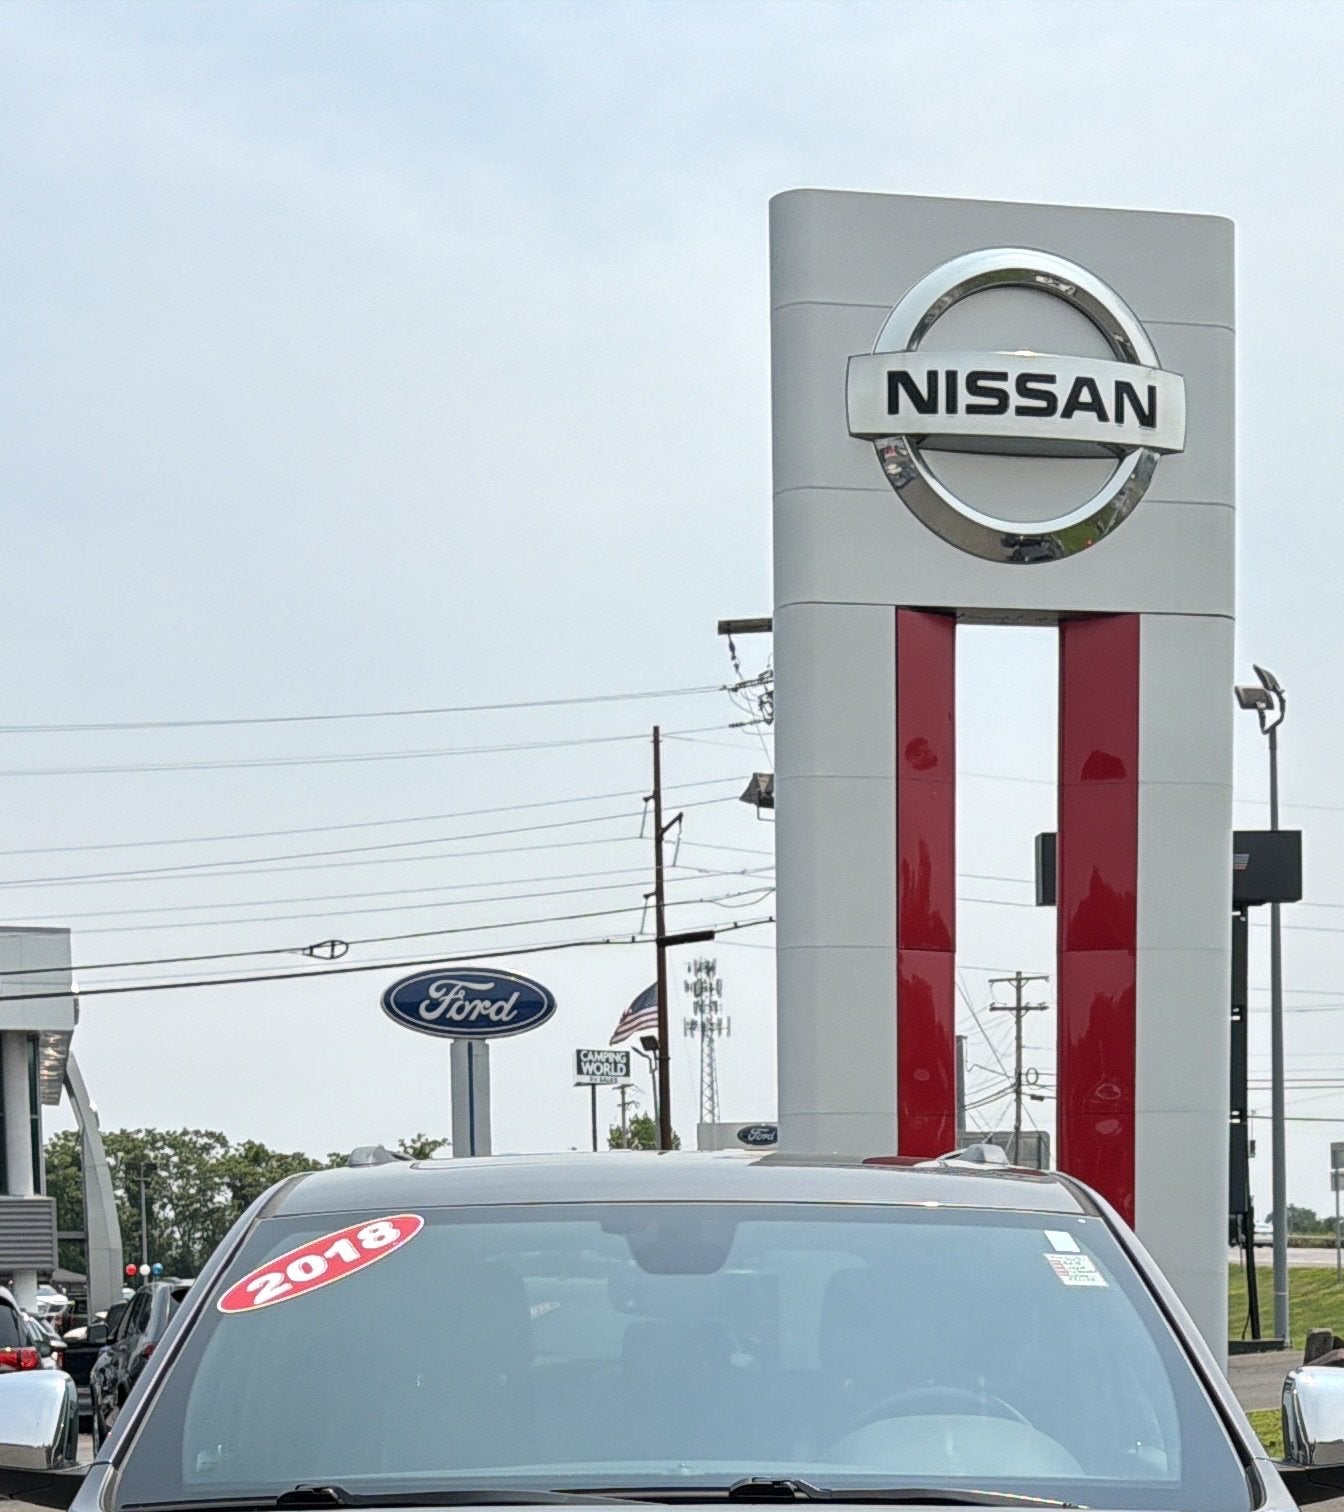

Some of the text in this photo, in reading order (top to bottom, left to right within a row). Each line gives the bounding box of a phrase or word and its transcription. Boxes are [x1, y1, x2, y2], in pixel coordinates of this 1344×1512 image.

[887, 369, 1157, 429] NISSAN
[419, 979, 521, 1022] Ford
[580, 1050, 626, 1063] CAMPING
[581, 1061, 626, 1076] WORLD
[747, 1128, 776, 1141] Ford
[246, 1220, 401, 1305] 2018
